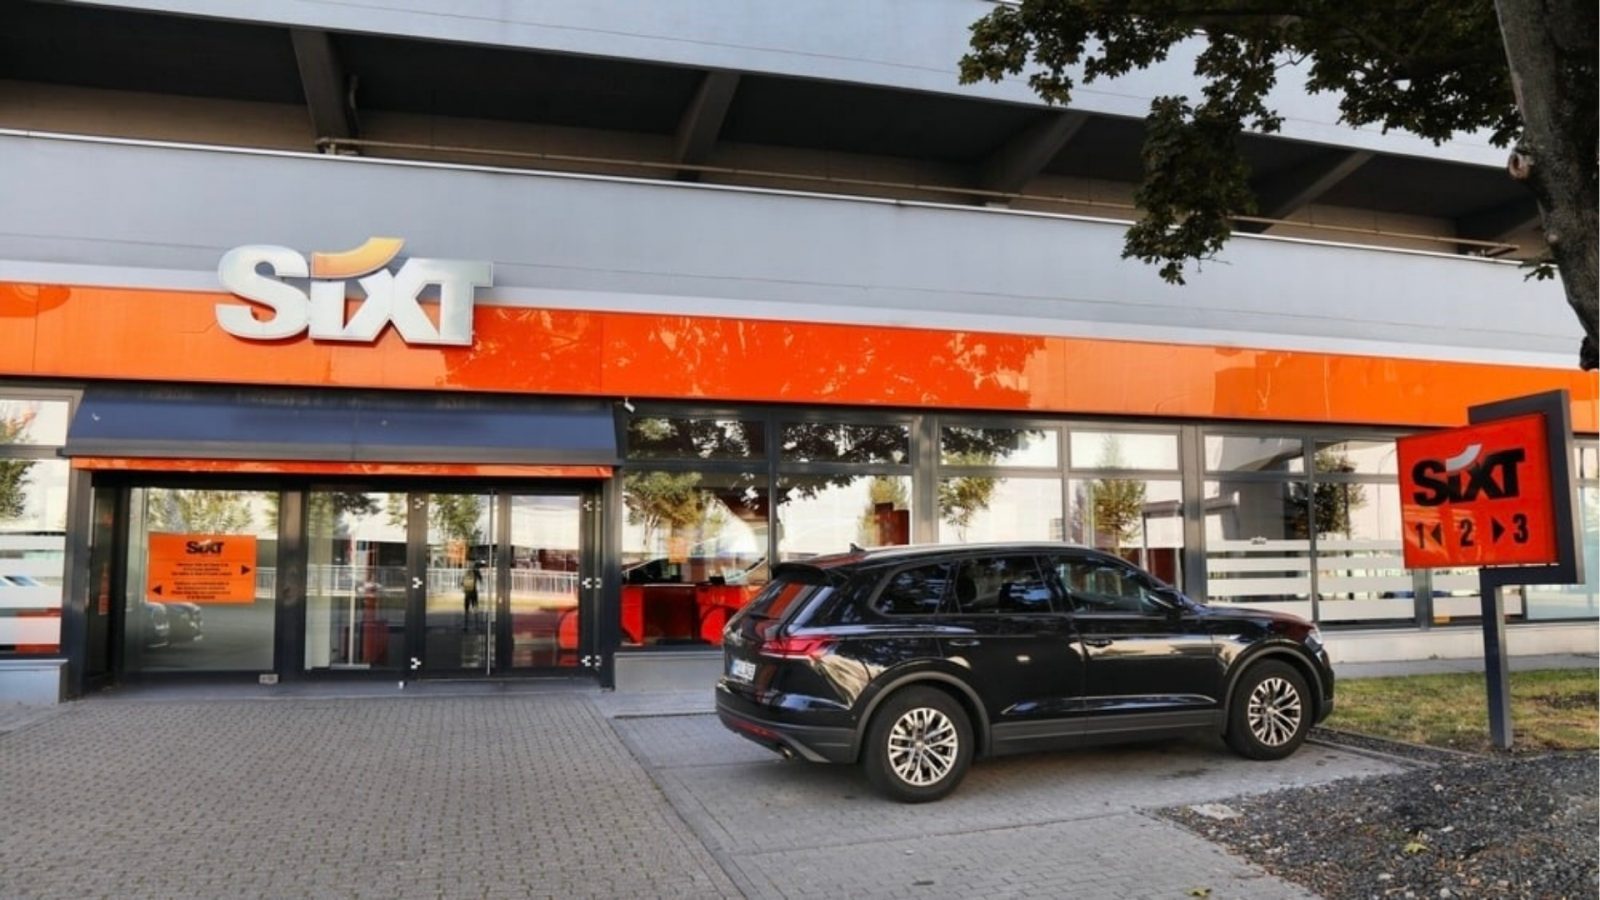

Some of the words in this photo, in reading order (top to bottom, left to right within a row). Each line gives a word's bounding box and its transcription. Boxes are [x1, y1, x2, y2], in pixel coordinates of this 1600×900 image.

[1415, 522, 1425, 549] 1
[1460, 518, 1475, 547] 2
[1512, 513, 1529, 544] 3
